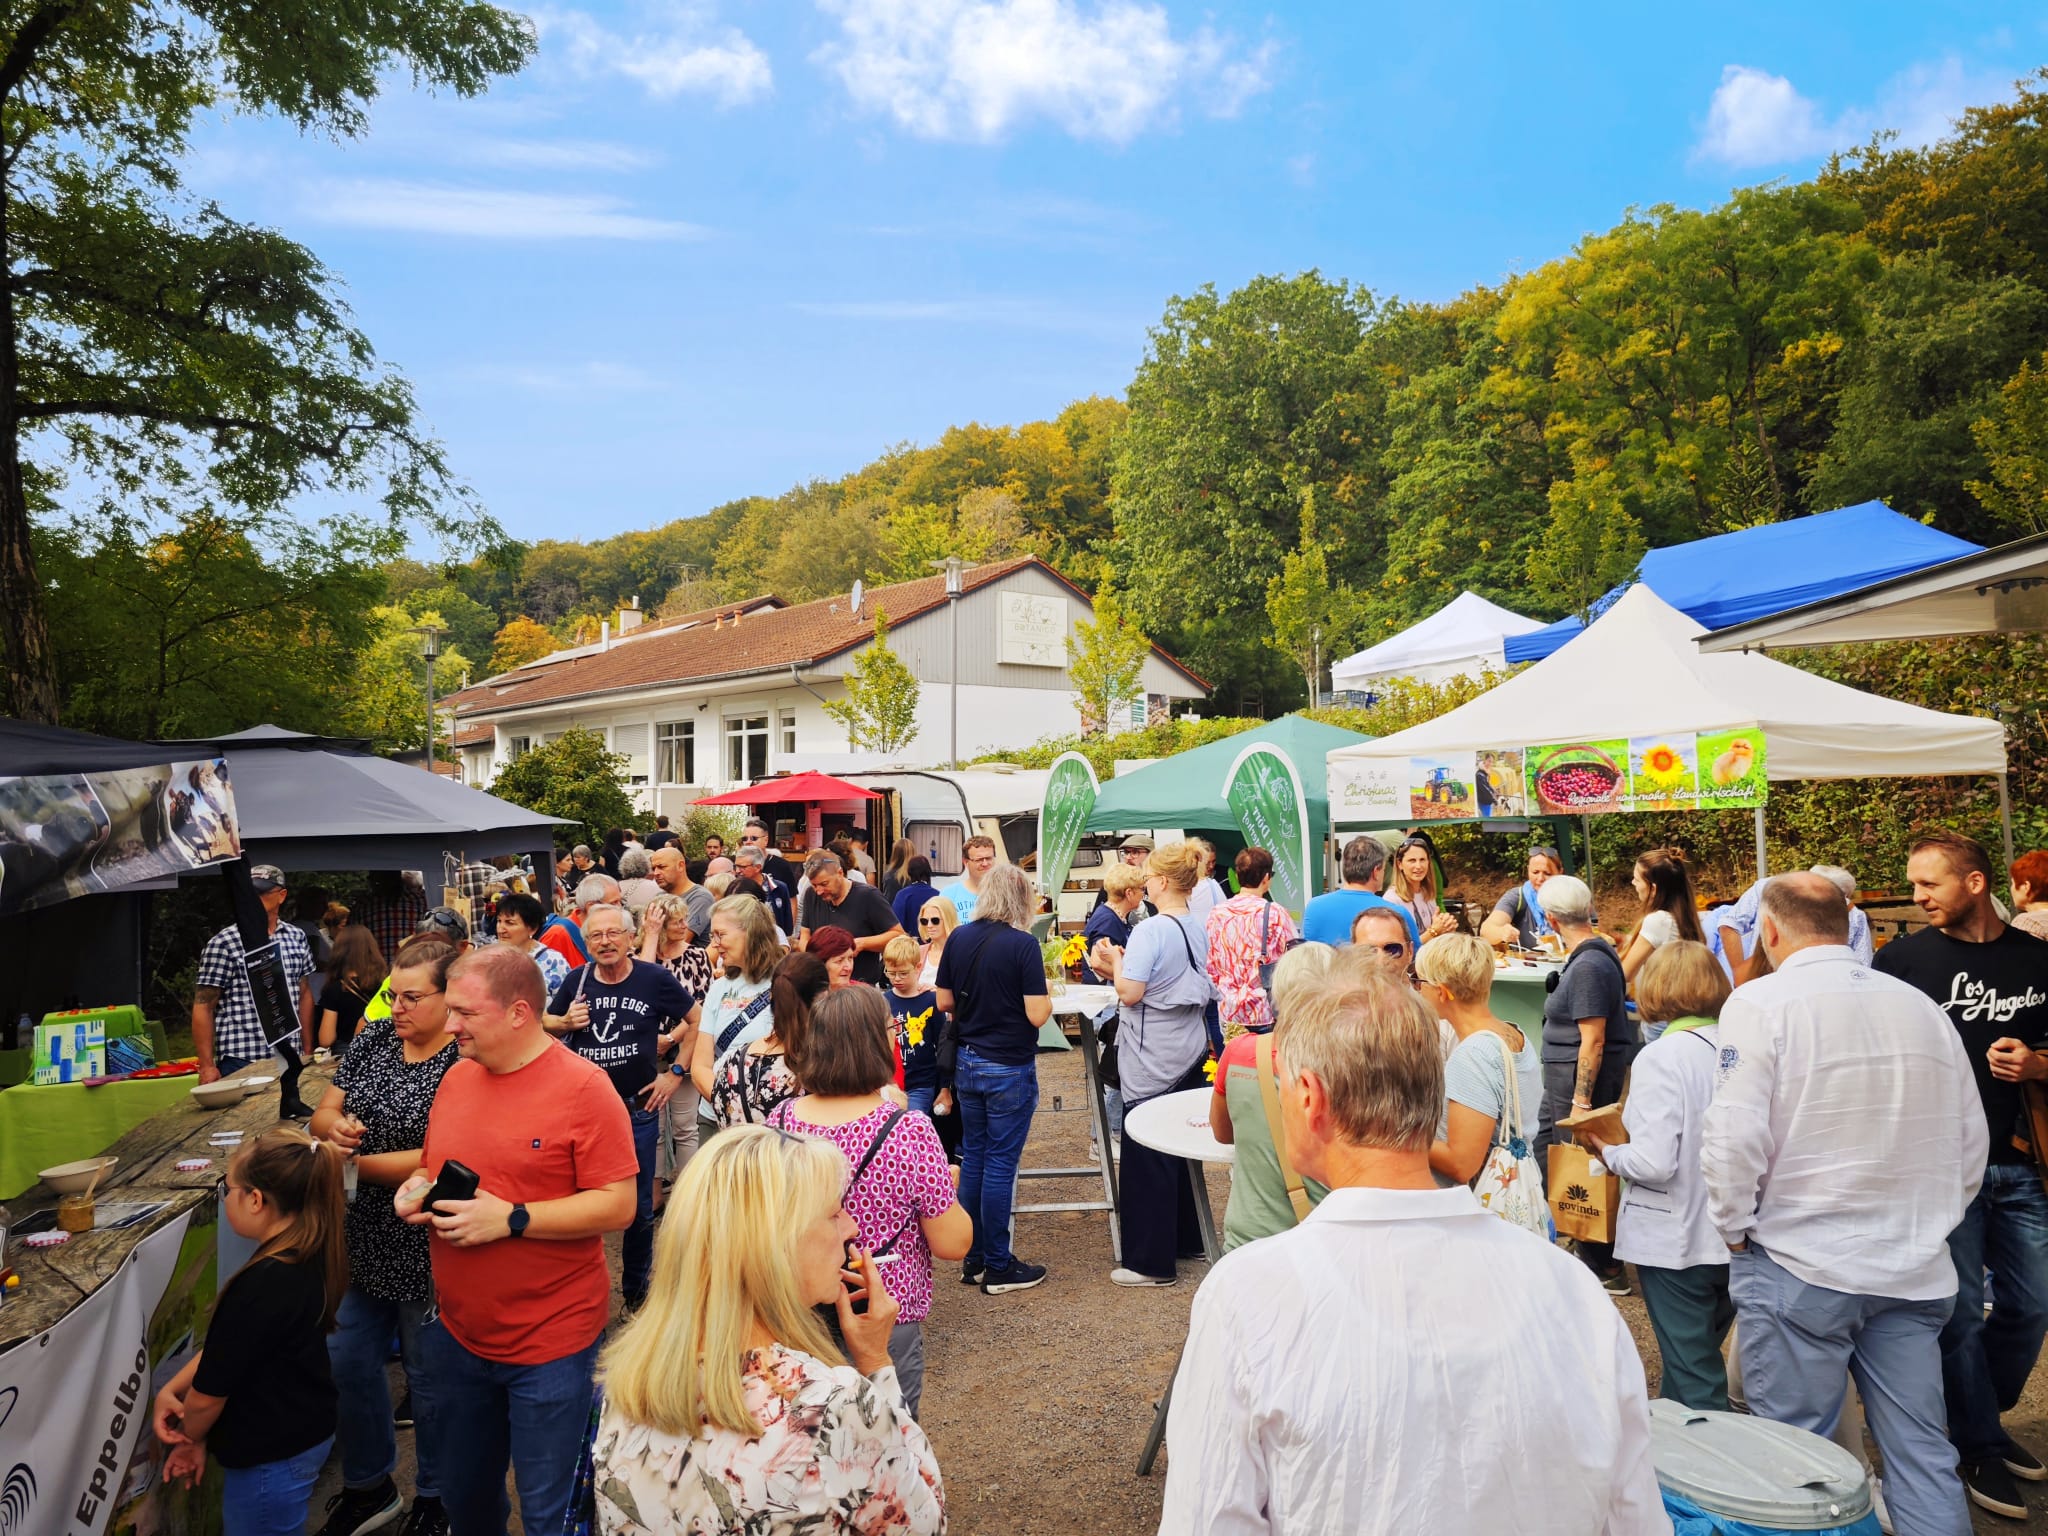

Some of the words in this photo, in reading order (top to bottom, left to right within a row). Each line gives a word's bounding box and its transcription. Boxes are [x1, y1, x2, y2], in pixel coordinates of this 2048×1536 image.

[1568, 791, 1610, 807] Regionale
[1672, 784, 1756, 802] Landwirtschaft
[1046, 832, 1067, 881] Landwirt
[595, 996, 618, 1010] PRO
[621, 997, 649, 1015] EDGE
[1941, 971, 1985, 1012] Los
[1961, 986, 2046, 1022] Angeles
[1558, 1201, 1599, 1216] govinda
[76, 1334, 148, 1528] Eppelbo
